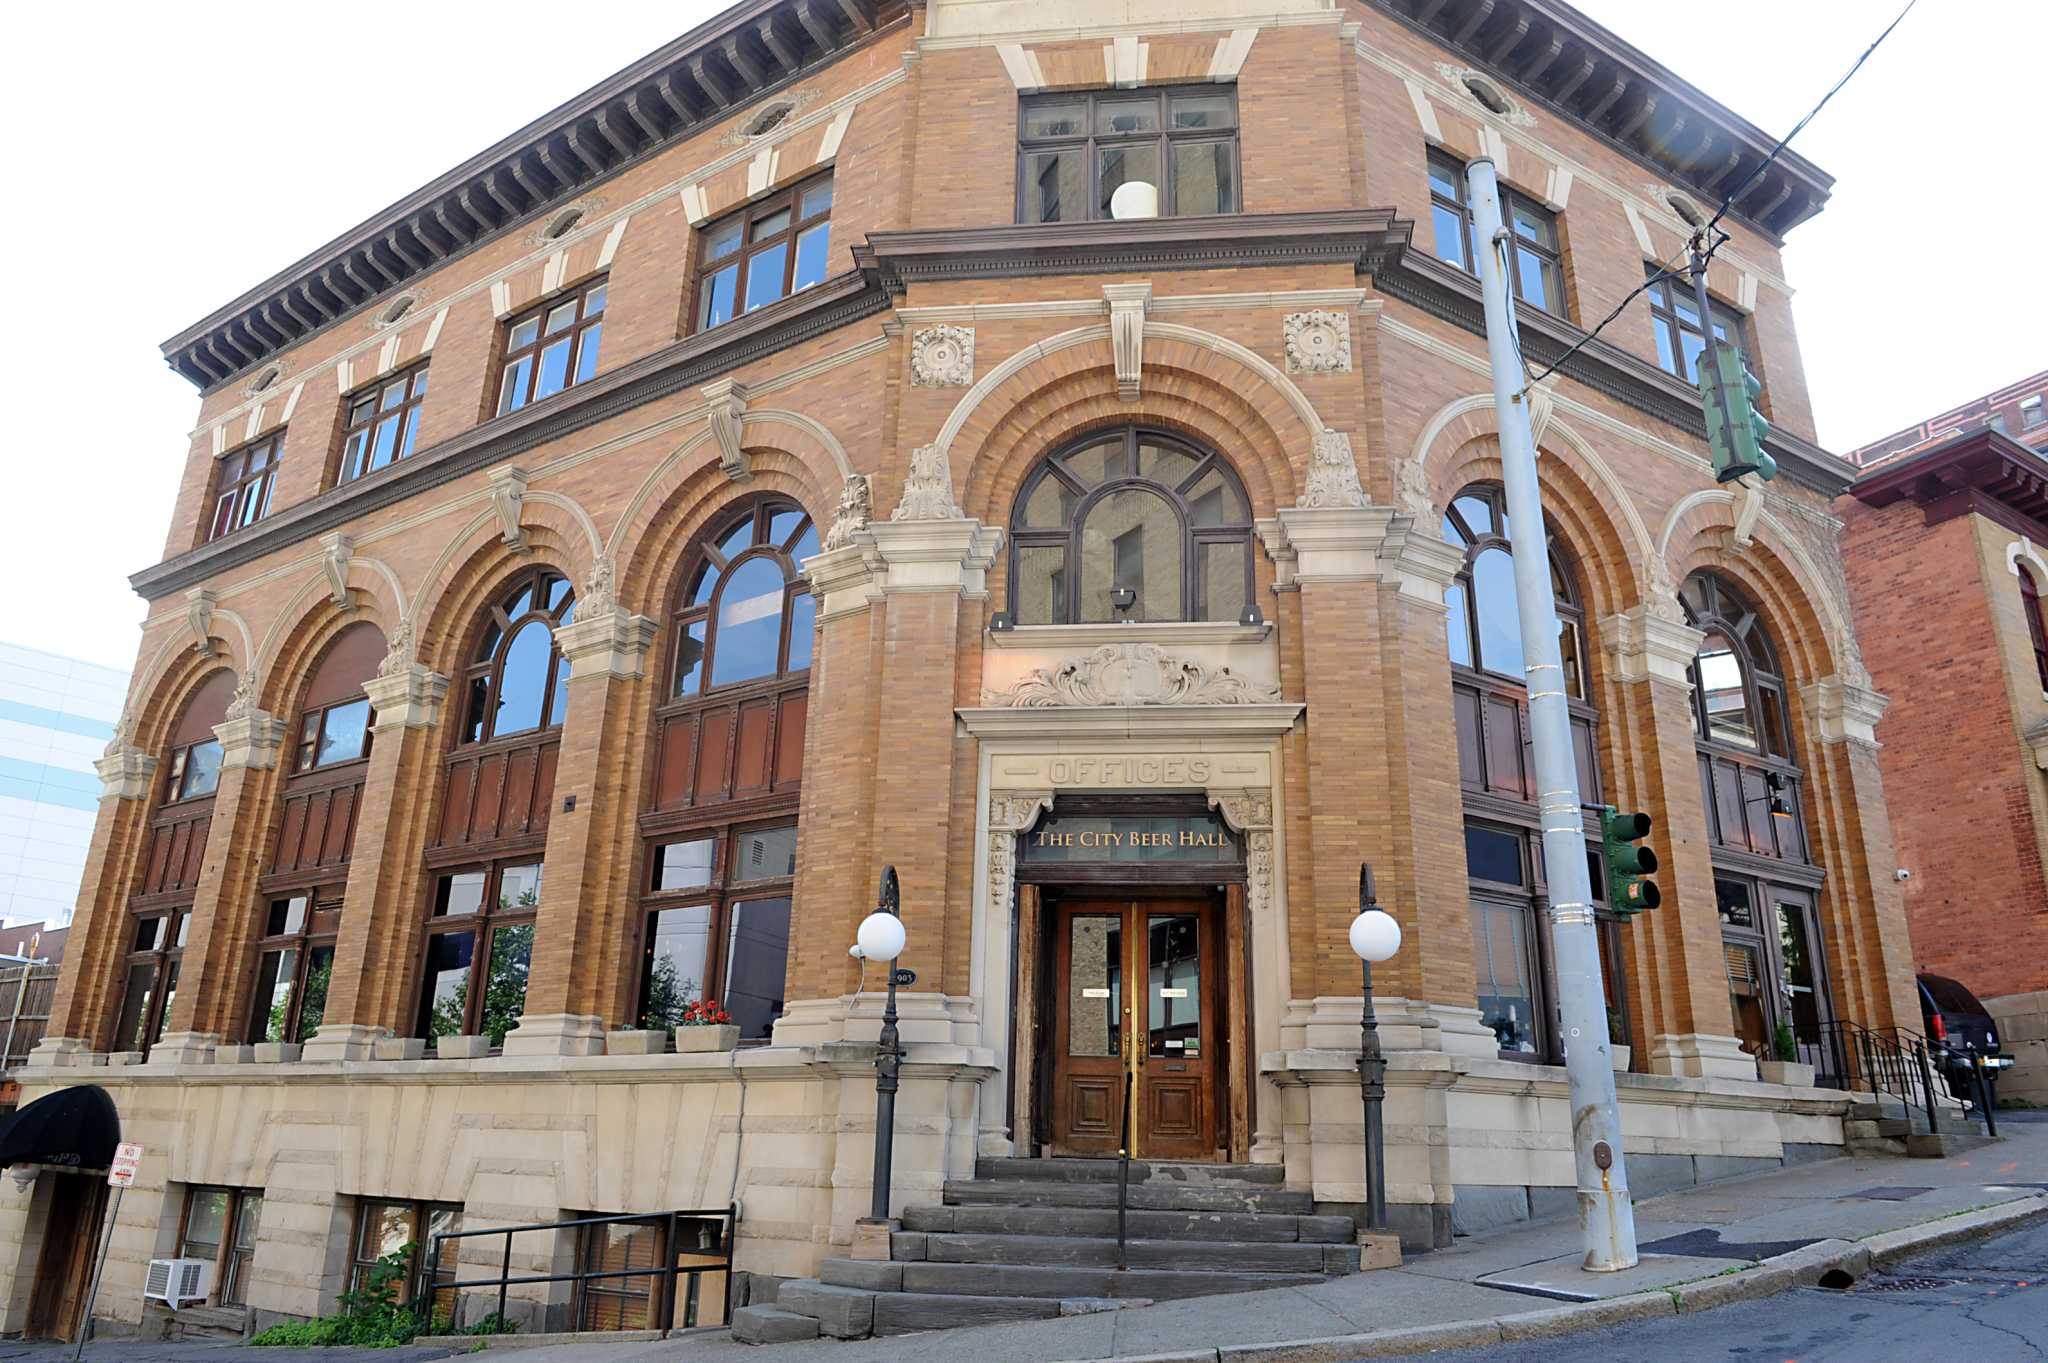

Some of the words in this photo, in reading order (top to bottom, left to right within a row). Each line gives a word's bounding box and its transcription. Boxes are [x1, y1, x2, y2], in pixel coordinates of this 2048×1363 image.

[1050, 759, 1210, 784] OFFICES
[1036, 831, 1073, 847] THE
[1080, 831, 1123, 847] CITY
[1129, 831, 1173, 847] BEER
[1179, 831, 1231, 847] HALL
[125, 1148, 135, 1156] NO
